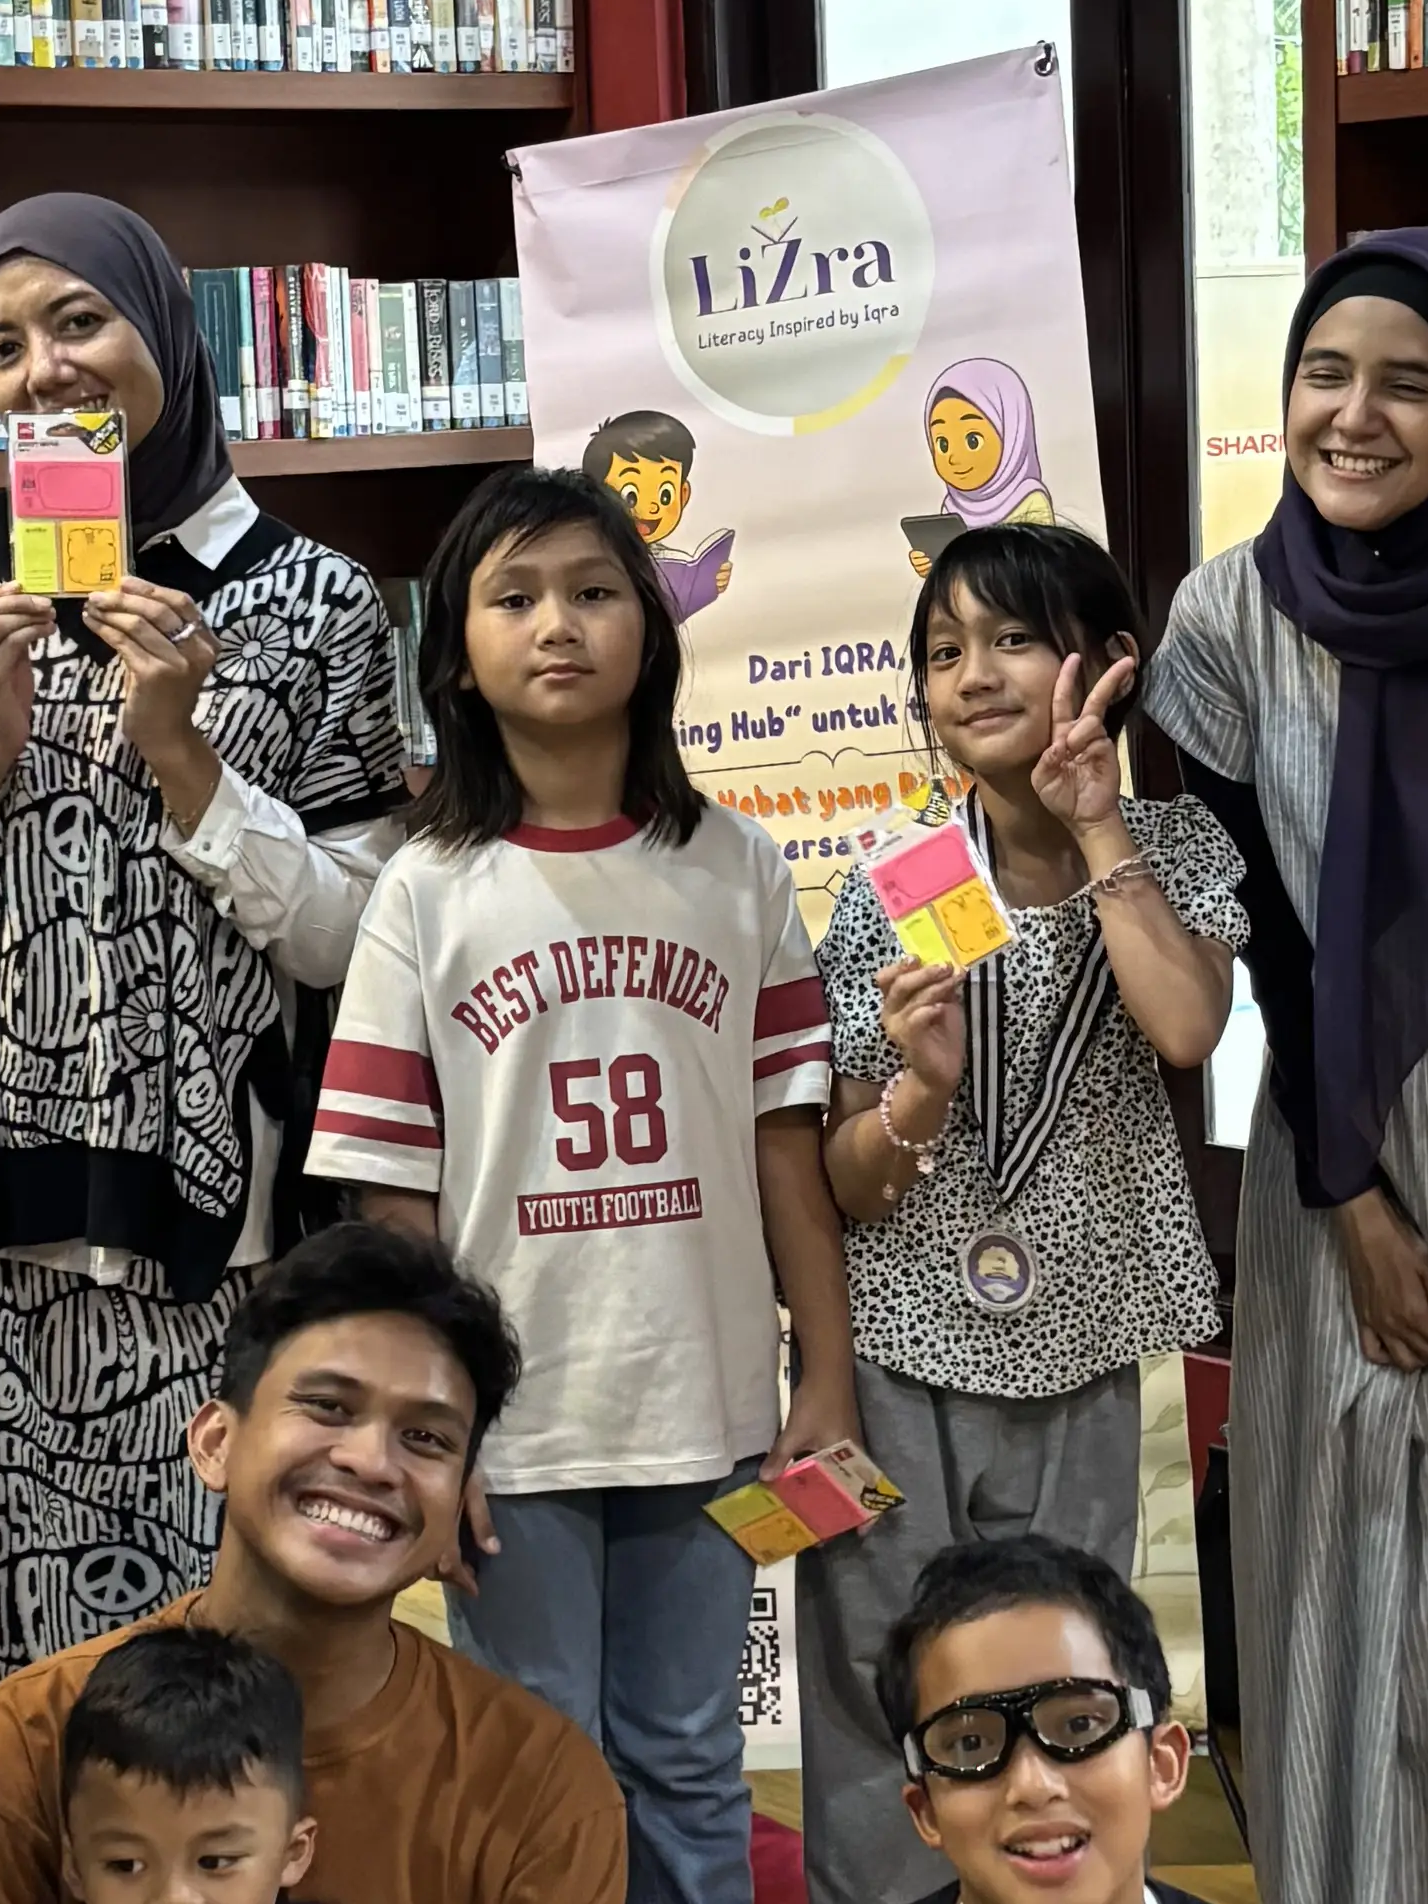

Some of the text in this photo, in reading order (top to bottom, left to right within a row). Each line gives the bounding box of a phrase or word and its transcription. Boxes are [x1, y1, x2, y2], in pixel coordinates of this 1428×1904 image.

[689, 237, 896, 317] LiZra
[698, 302, 900, 351] Literacy Inspired by Iqra
[426, 334, 444, 378] RINGS
[1207, 434, 1285, 456] SHARI
[748, 639, 905, 684] Dari IQRA,
[812, 694, 898, 733] untuk
[818, 782, 893, 822] yang
[784, 836, 851, 862] ersa
[452, 936, 729, 1055] BEST DEFENDER
[548, 1053, 667, 1172] 58
[525, 1183, 700, 1230] YOUTH FOOTBALL
